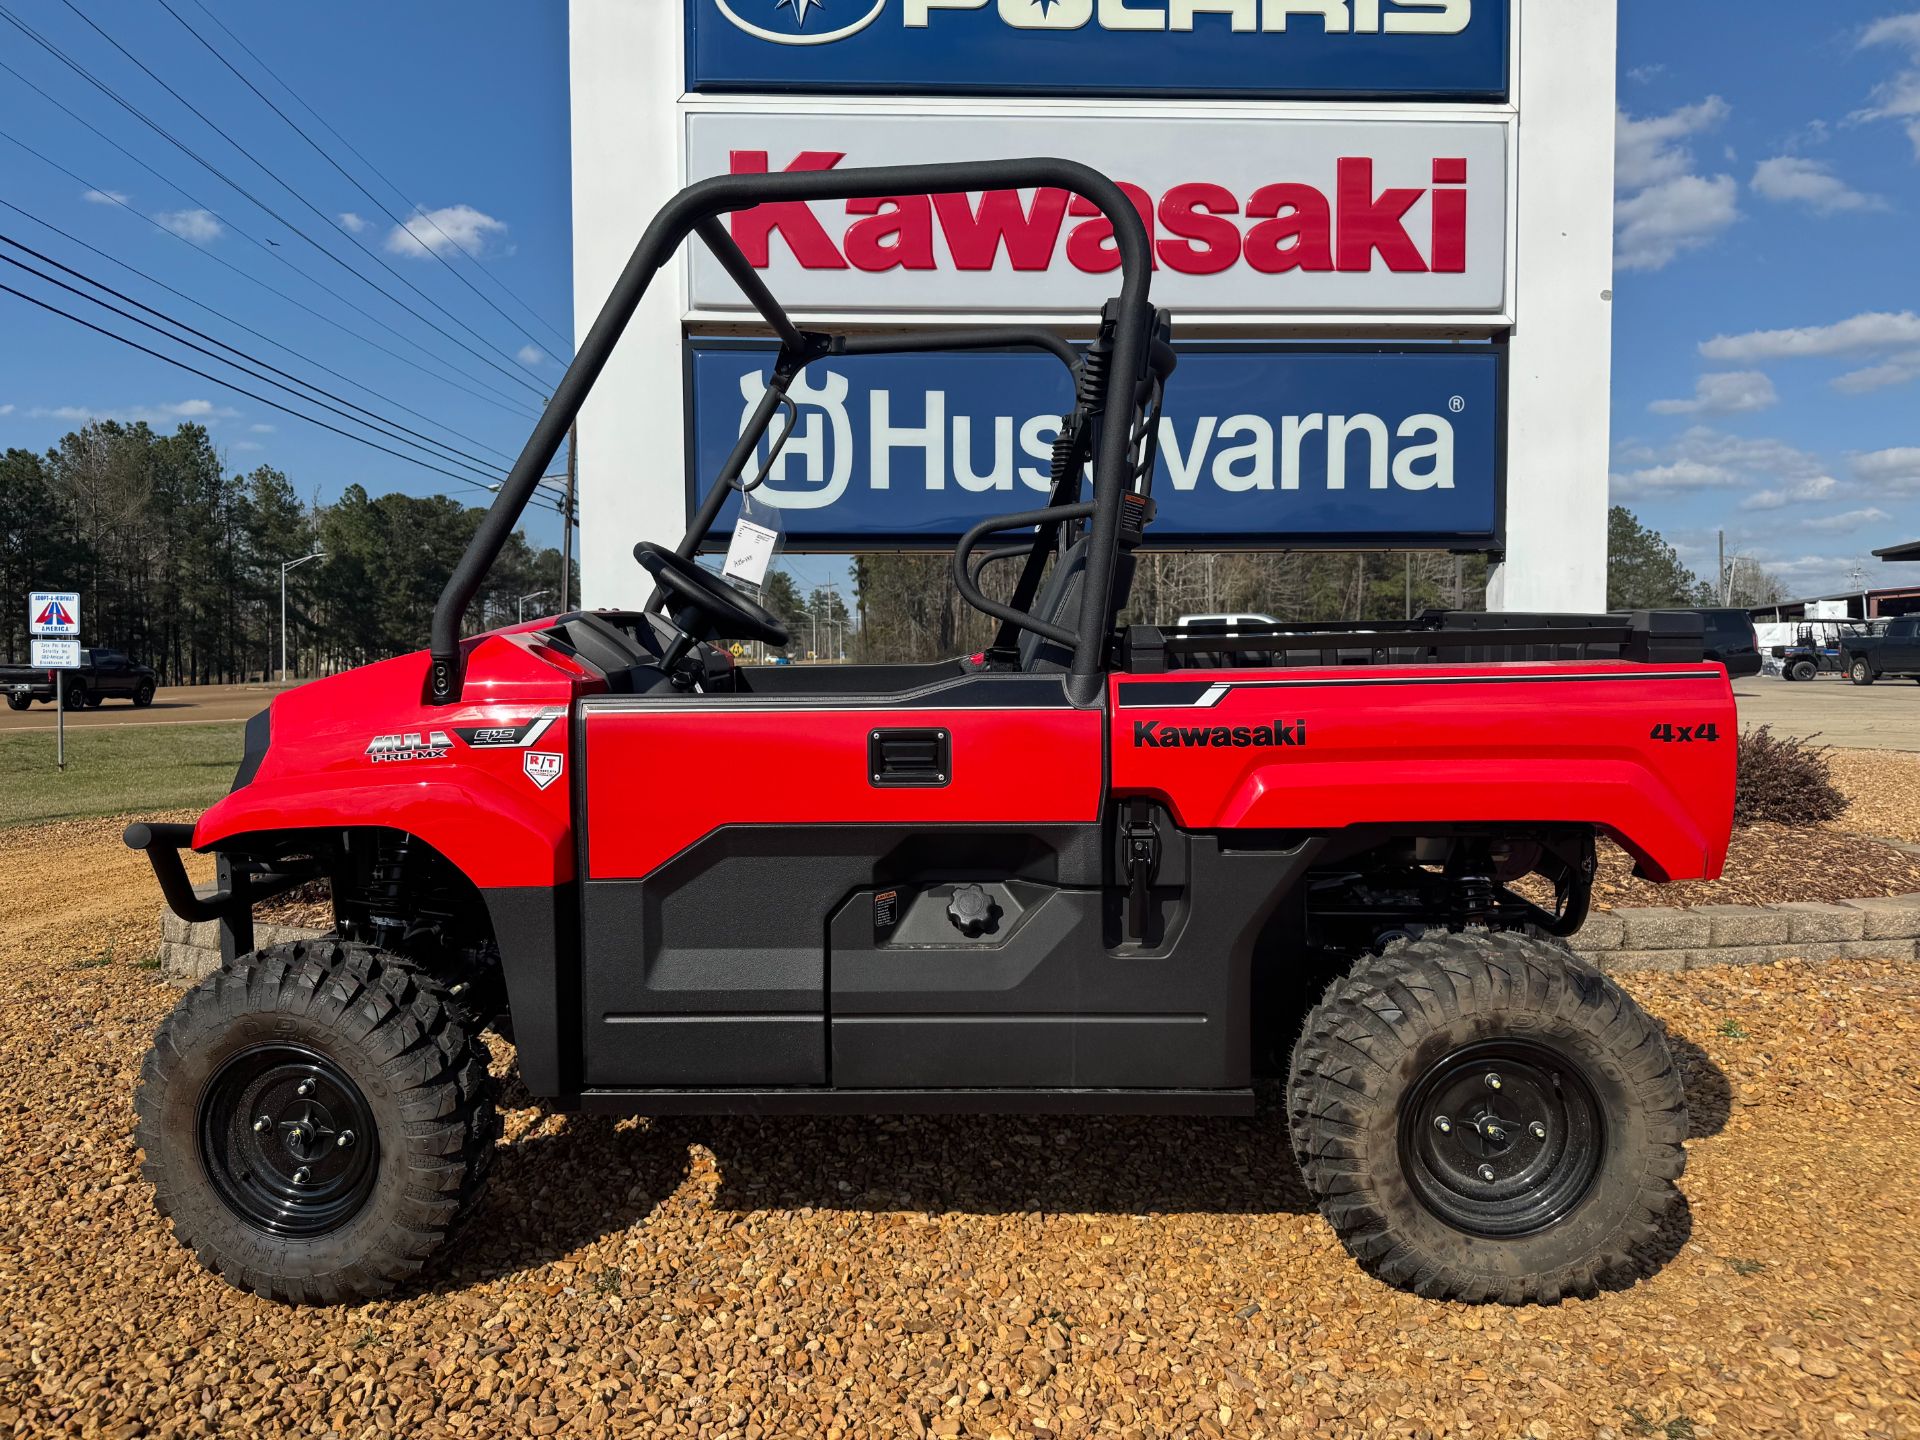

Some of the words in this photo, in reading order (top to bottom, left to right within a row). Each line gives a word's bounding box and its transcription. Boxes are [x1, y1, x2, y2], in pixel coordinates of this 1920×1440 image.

[729, 150, 1467, 274] Kawasaki
[869, 389, 1455, 493] Husvarna
[364, 731, 455, 754] MULE
[371, 749, 448, 763] PRO-MX
[1133, 719, 1307, 748] Kawasaki
[1650, 723, 1720, 743] 4x4
[273, 1016, 388, 1098] DURO
[1507, 1014, 1623, 1083] DURO
